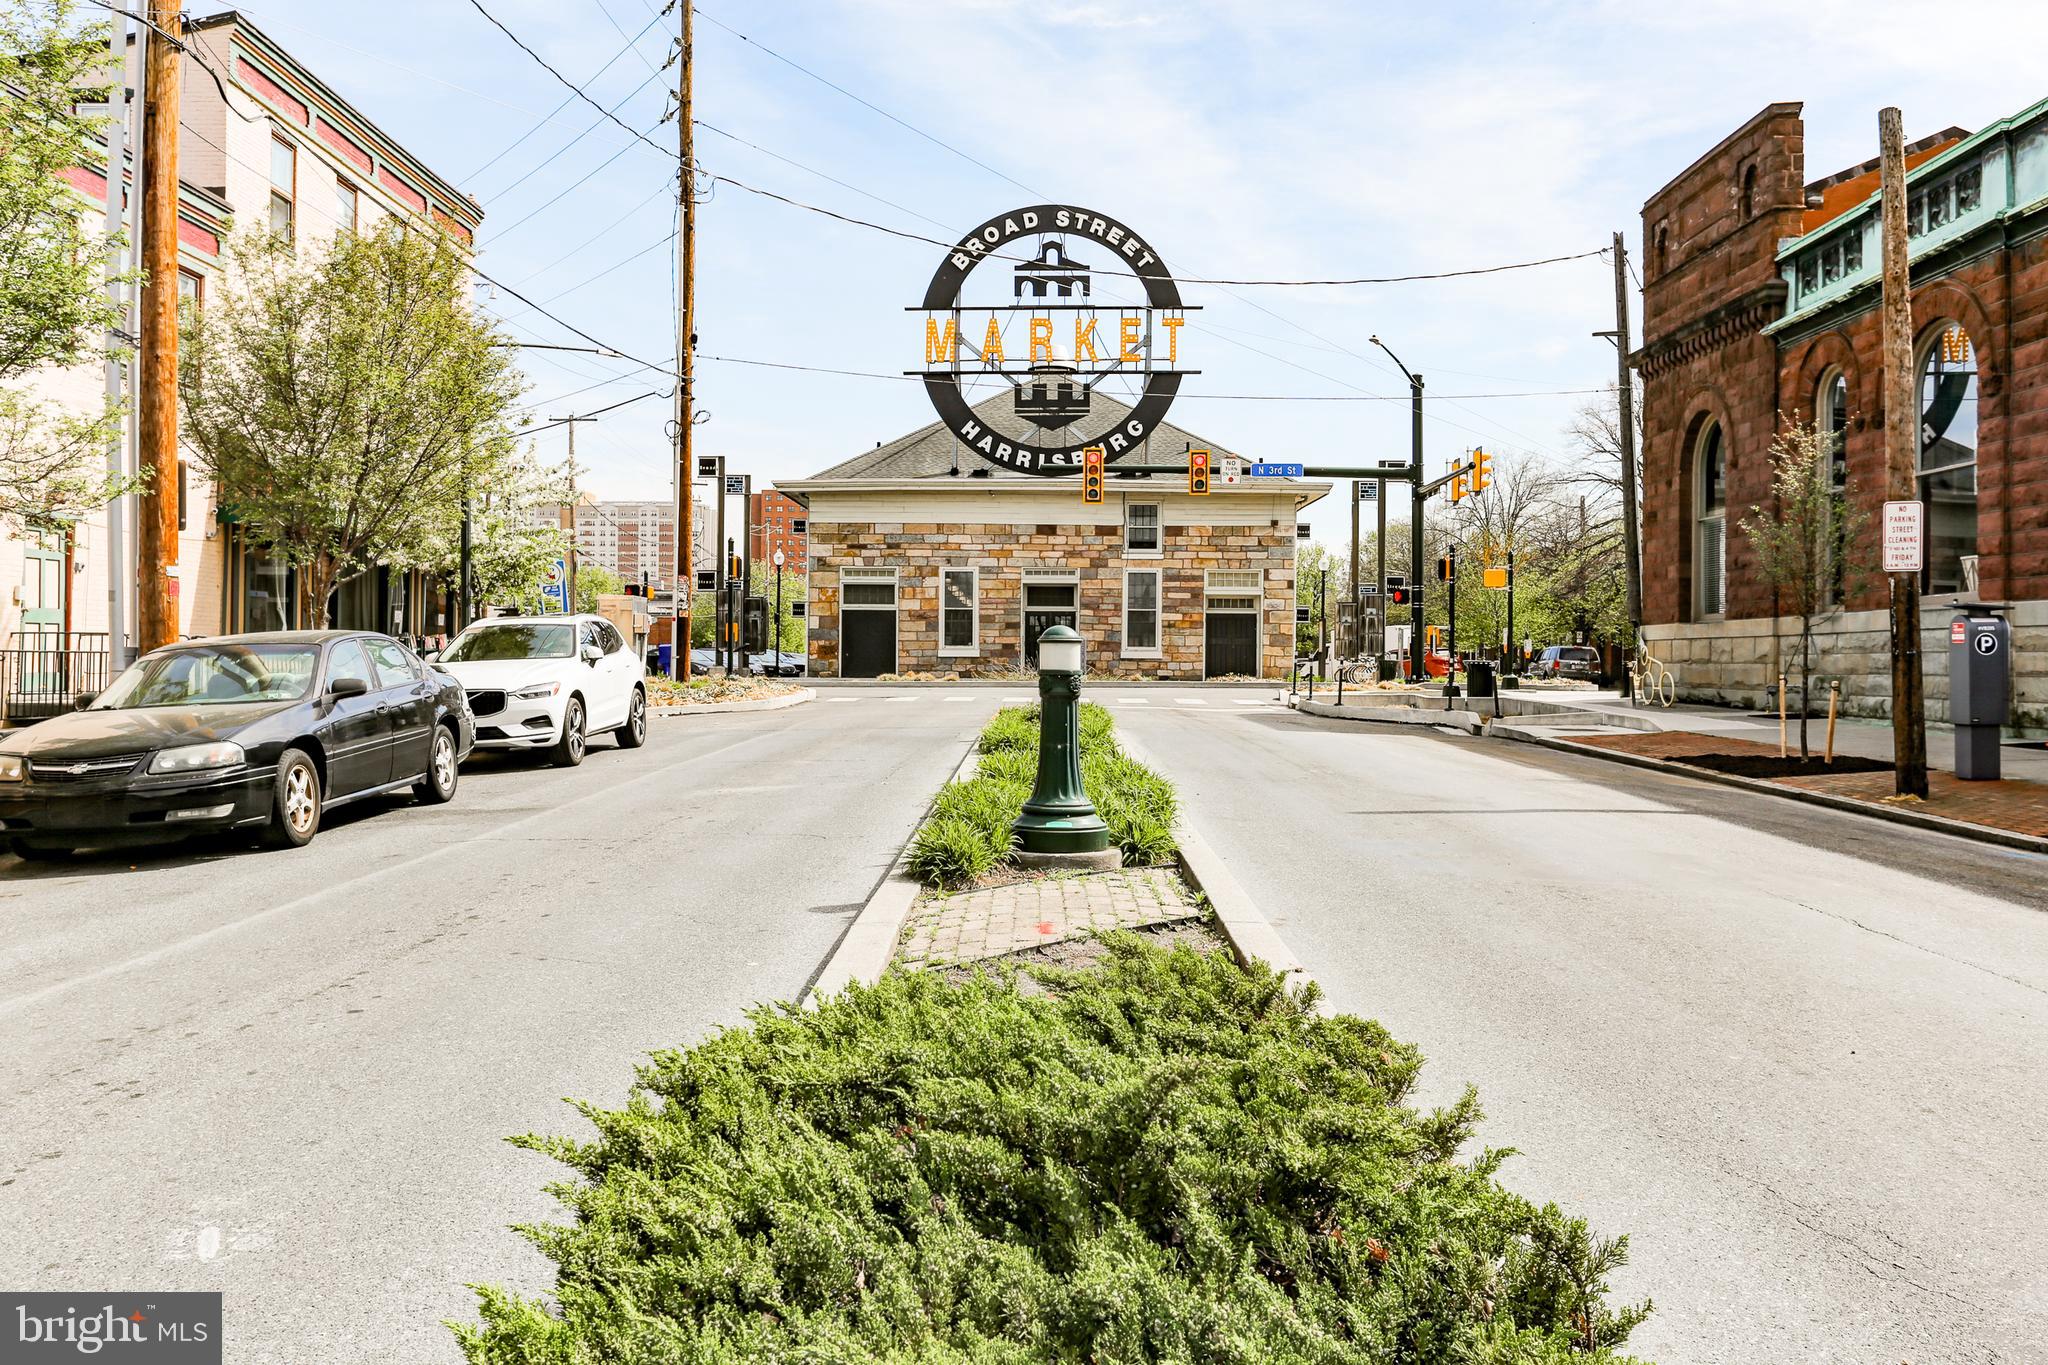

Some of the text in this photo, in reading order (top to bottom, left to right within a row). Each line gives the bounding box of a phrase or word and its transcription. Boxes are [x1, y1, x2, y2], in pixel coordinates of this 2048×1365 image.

[950, 210, 1154, 271] BROAD STREET
[926, 318, 1184, 363] MARKET
[1258, 466, 1296, 474] N 3rd St
